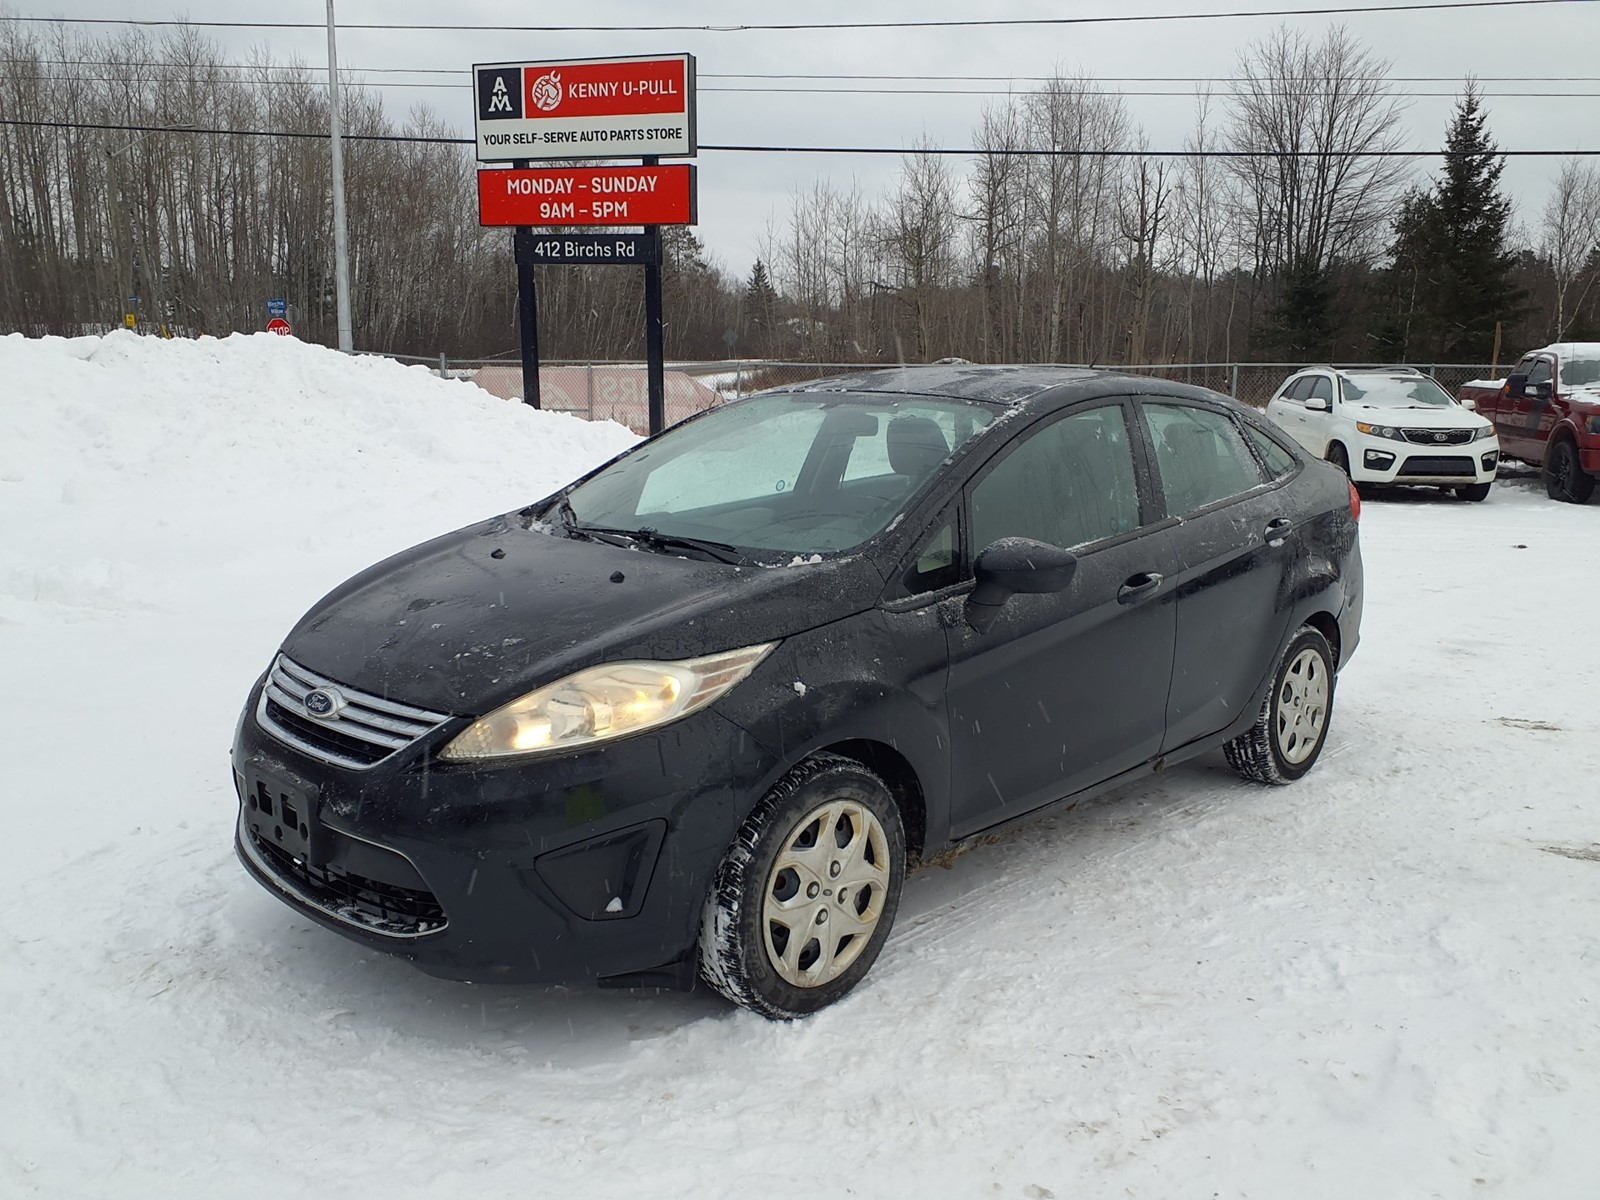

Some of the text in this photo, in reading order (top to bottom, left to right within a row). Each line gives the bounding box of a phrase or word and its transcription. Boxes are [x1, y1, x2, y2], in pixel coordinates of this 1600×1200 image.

[568, 79, 677, 98] KENNY U-PULL
[483, 128, 682, 145] YOUR SELF-SERVE AUTO PARTS STORE
[507, 178, 574, 194] MONDAY
[591, 176, 658, 193] SUNDAY
[540, 202, 574, 218] 9AM
[592, 201, 628, 217] 5PM
[535, 241, 634, 257] 412 Birchs Rd
[308, 694, 328, 711] Ford
